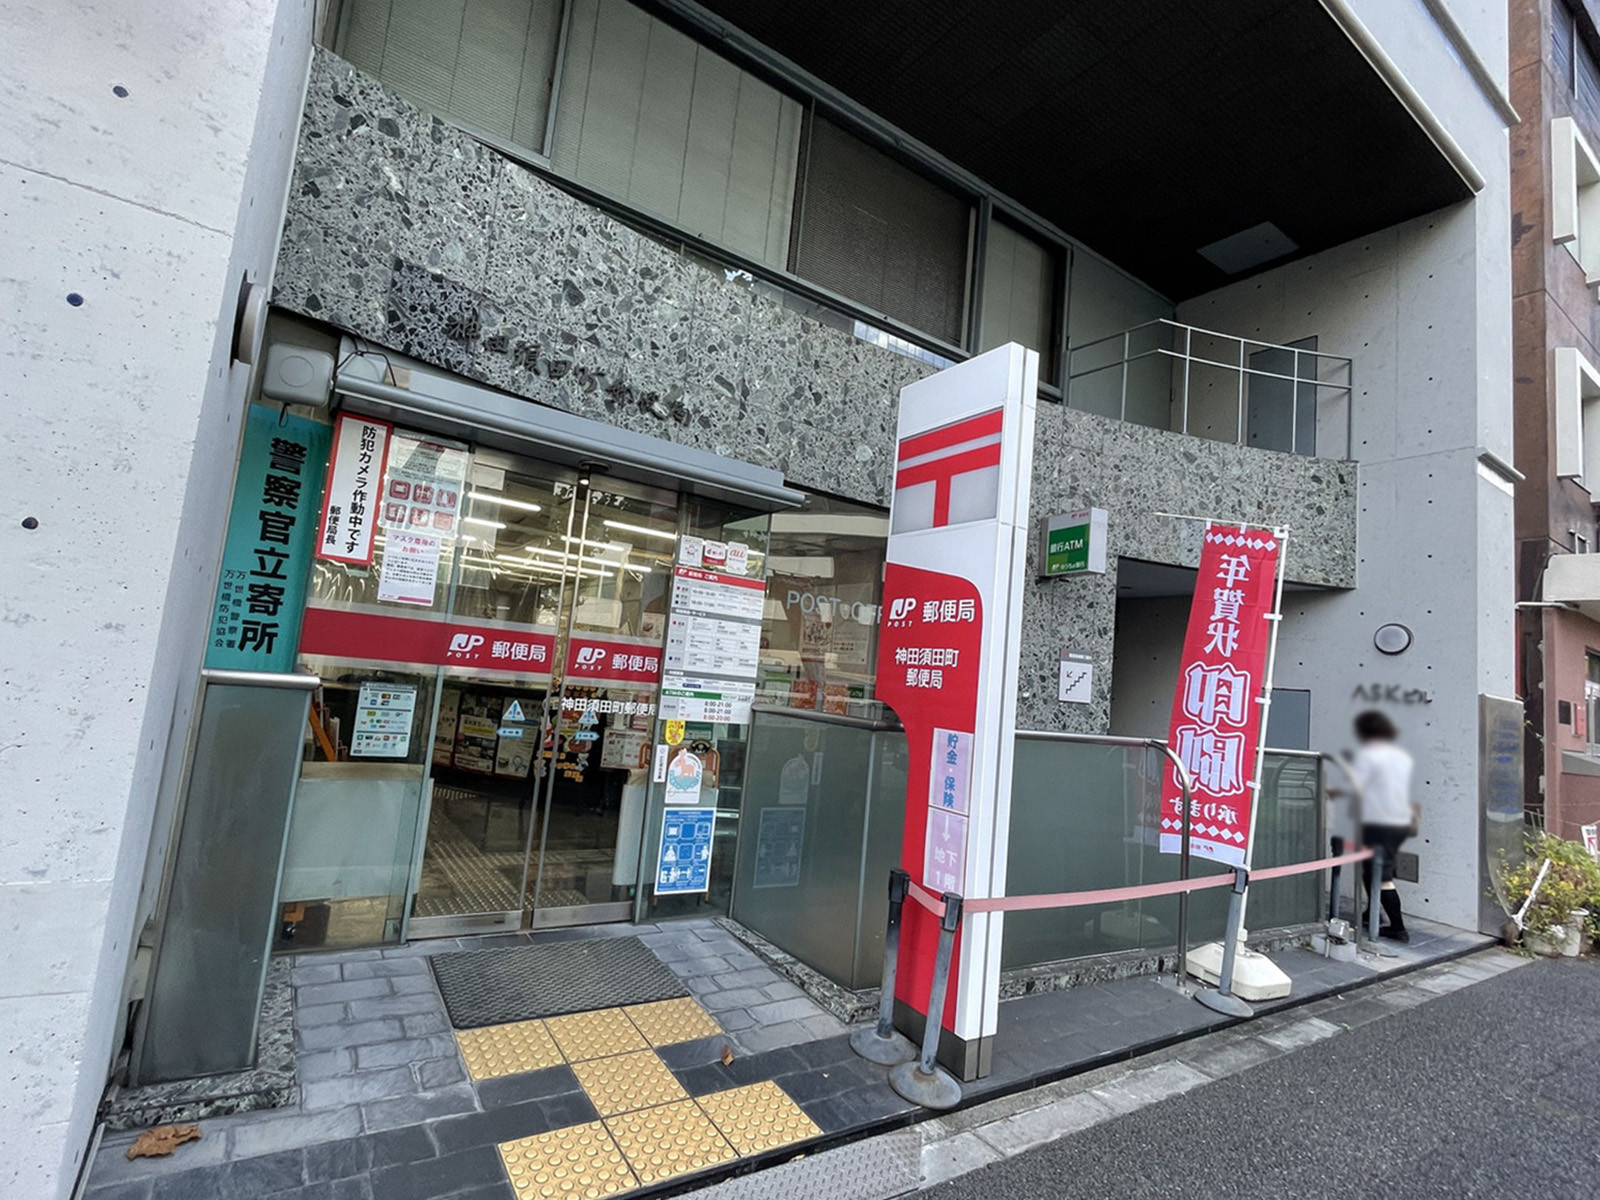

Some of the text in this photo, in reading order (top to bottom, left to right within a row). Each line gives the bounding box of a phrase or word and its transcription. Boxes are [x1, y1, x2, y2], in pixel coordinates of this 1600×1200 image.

[345, 425, 377, 554] 防犯カメラ作動中です
[325, 505, 342, 546] 郵便局長
[238, 437, 308, 655] 警察官立寄所
[786, 590, 841, 617] POST
[889, 598, 976, 624] JP 郵便局
[887, 620, 913, 628] POST
[446, 651, 480, 660] POST
[449, 633, 547, 663] JP 郵便局
[576, 647, 660, 674] JP 郵便局
[895, 647, 960, 668] 神田須田町
[905, 668, 943, 690] 郵便局
[934, 847, 958, 867] 地下
